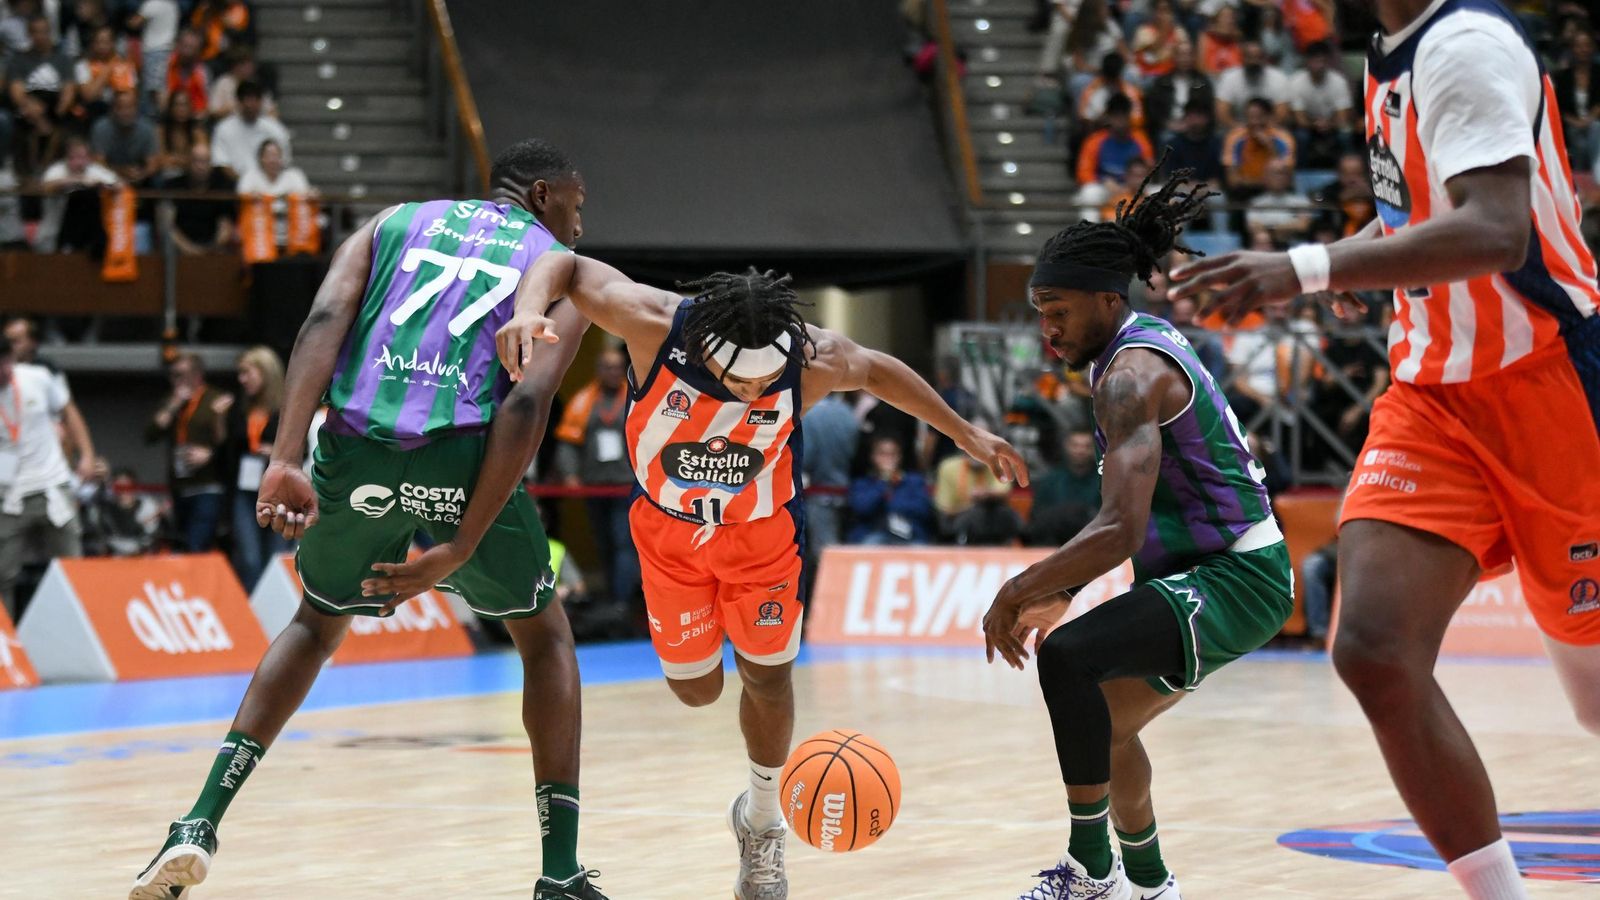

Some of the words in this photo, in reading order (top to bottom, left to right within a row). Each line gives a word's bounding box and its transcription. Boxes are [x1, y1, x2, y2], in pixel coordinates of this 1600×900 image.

[454, 201, 526, 231] Sima
[390, 247, 522, 338] 77
[677, 448, 750, 469] Estrella
[678, 464, 744, 485] Galicia
[400, 482, 466, 503] COSTA
[400, 496, 432, 512] DEL
[690, 496, 722, 524] 11
[842, 561, 1018, 636] LEYM
[219, 745, 253, 790] UNICAJA
[537, 794, 551, 838] UNICAJA
[870, 808, 885, 837] acb
